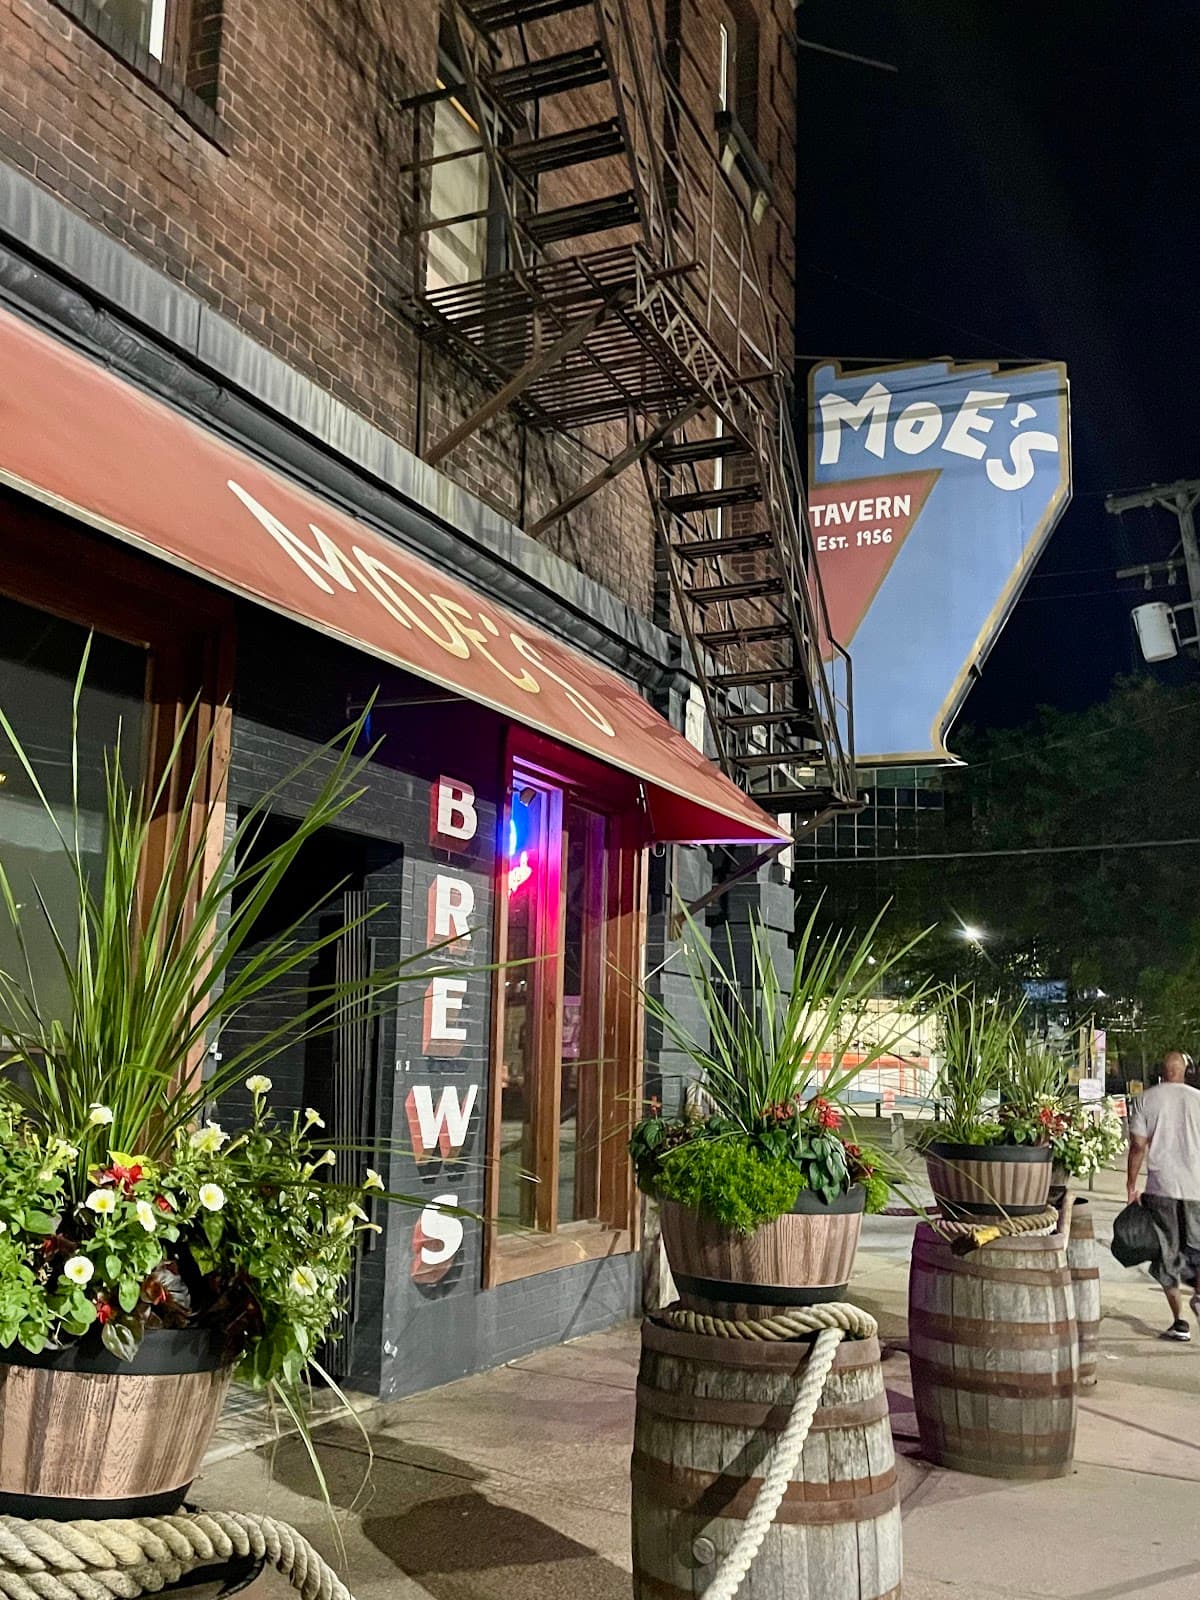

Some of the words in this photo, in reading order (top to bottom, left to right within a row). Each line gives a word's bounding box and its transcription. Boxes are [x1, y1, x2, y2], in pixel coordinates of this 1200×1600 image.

[808, 494, 911, 528] TAVERN
[856, 527, 893, 547] 1956
[227, 479, 617, 738] MOE'S
[408, 775, 479, 1266] BREWS
